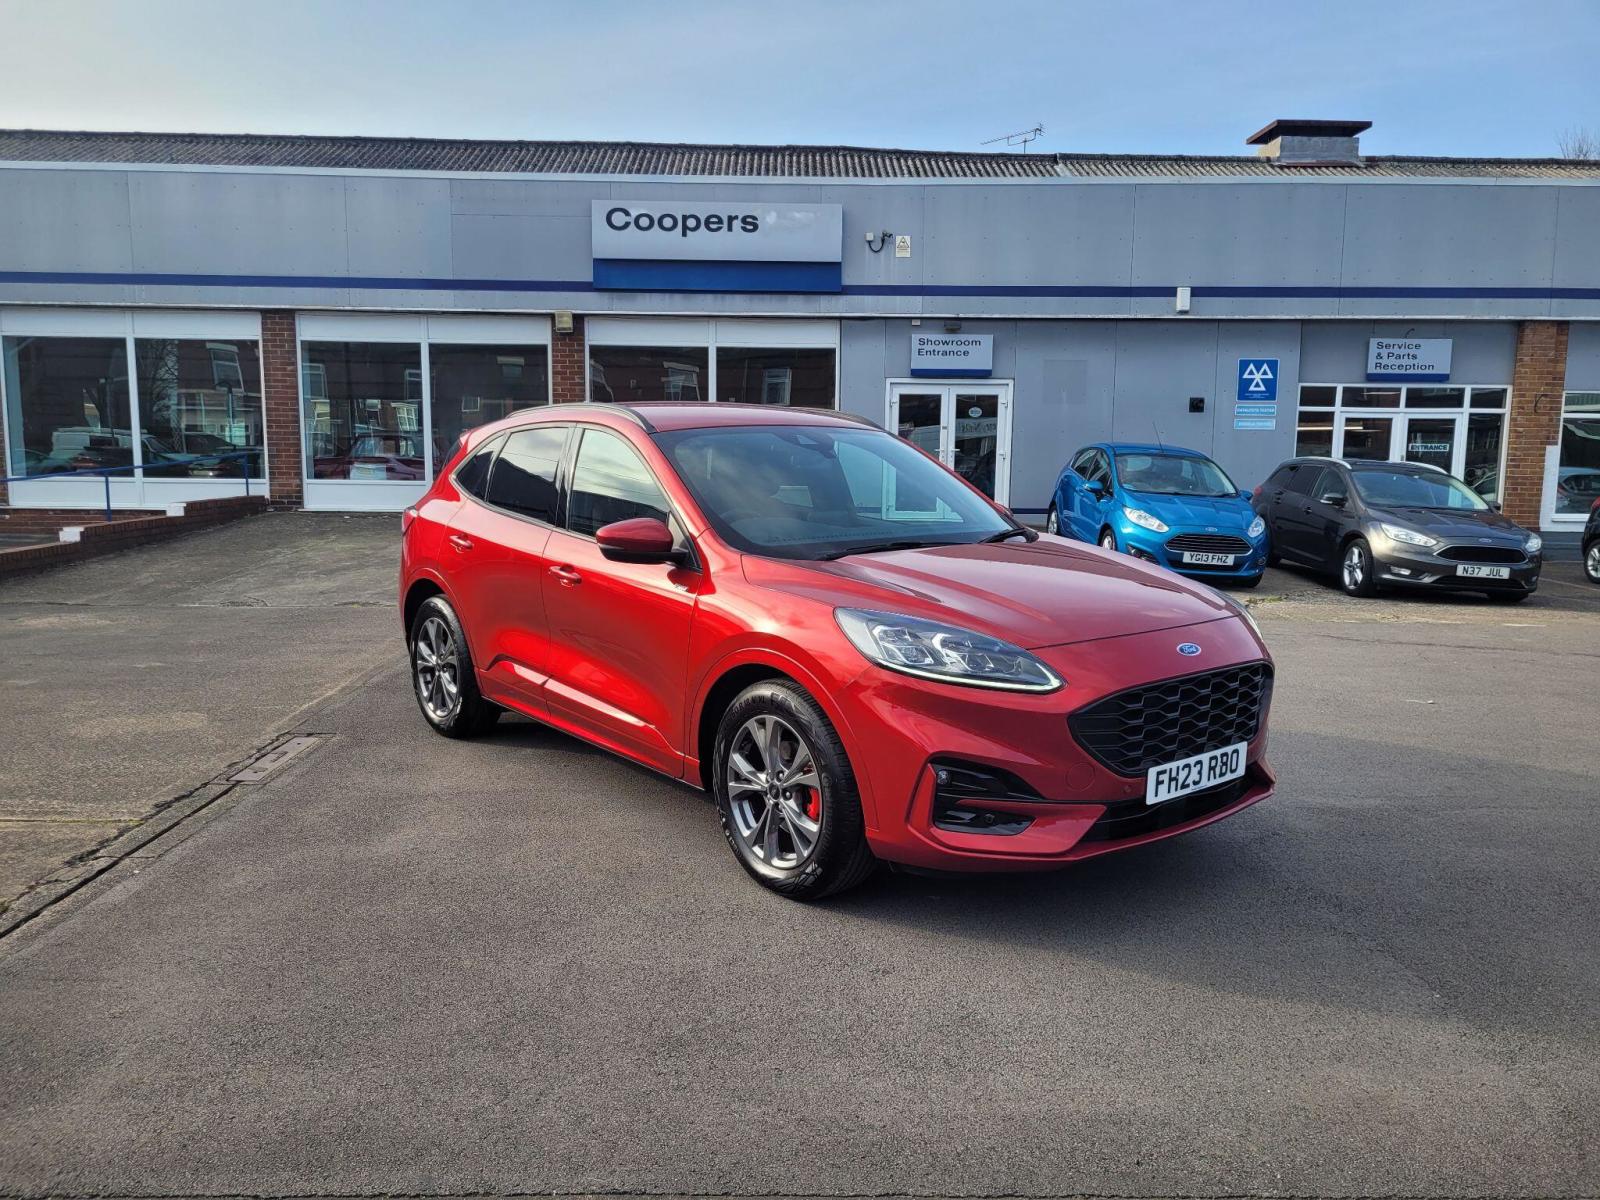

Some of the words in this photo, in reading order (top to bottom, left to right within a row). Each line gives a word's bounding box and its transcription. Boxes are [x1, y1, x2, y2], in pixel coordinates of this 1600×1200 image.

[605, 207, 760, 237] Coopers
[918, 337, 982, 347] Showroom
[1376, 341, 1422, 350] Service
[917, 348, 970, 357] Entrance
[1375, 352, 1383, 360] &
[1387, 352, 1418, 360] Parts
[1374, 362, 1435, 372] Reception
[1189, 552, 1210, 562] YG13
[1211, 554, 1229, 564] FHZ
[1462, 566, 1482, 576] N37
[1485, 567, 1504, 578] JUL
[1154, 759, 1204, 798] FH23
[1207, 748, 1240, 782] RBO
